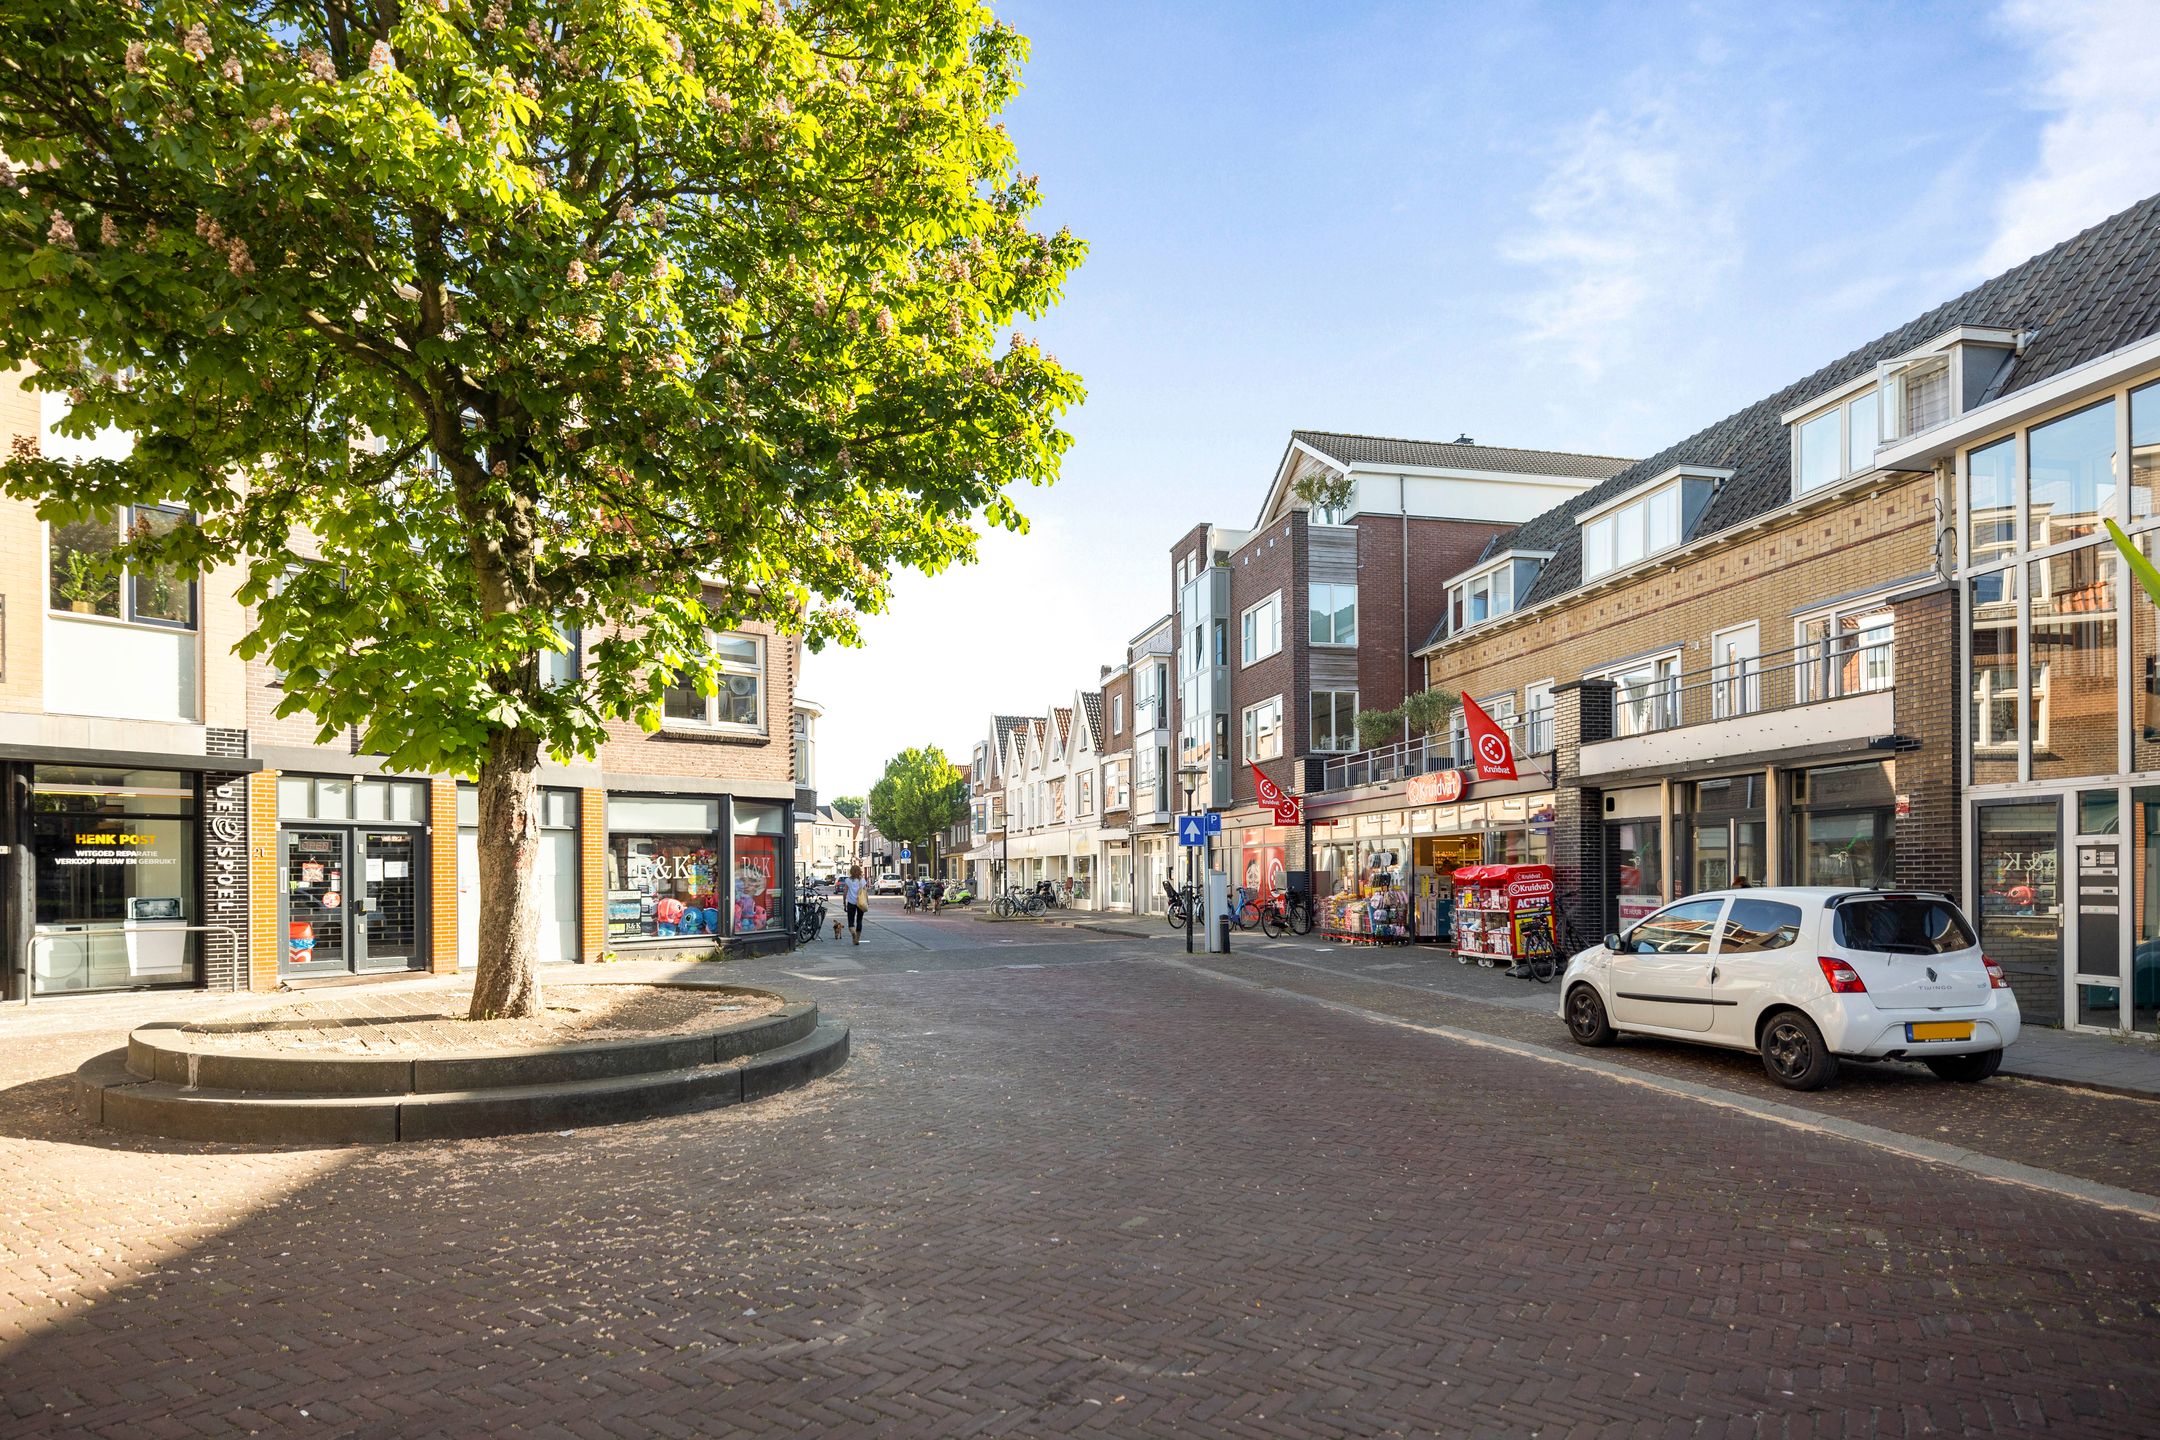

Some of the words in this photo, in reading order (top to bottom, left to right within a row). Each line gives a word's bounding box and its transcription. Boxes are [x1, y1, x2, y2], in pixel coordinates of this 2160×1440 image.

[1483, 765, 1511, 774] Kruidvat
[1420, 780, 1456, 797] Kruidvat
[216, 787, 232, 811] DE
[1210, 815, 1217, 824] P
[75, 834, 117, 844] HENK
[119, 834, 158, 844] POST
[301, 841, 329, 850] OPEN
[254, 847, 264, 857] 21
[636, 855, 691, 880] R&K
[741, 856, 771, 878] R&K
[217, 846, 234, 911] SPOEL
[1520, 882, 1549, 892] Kruidvat
